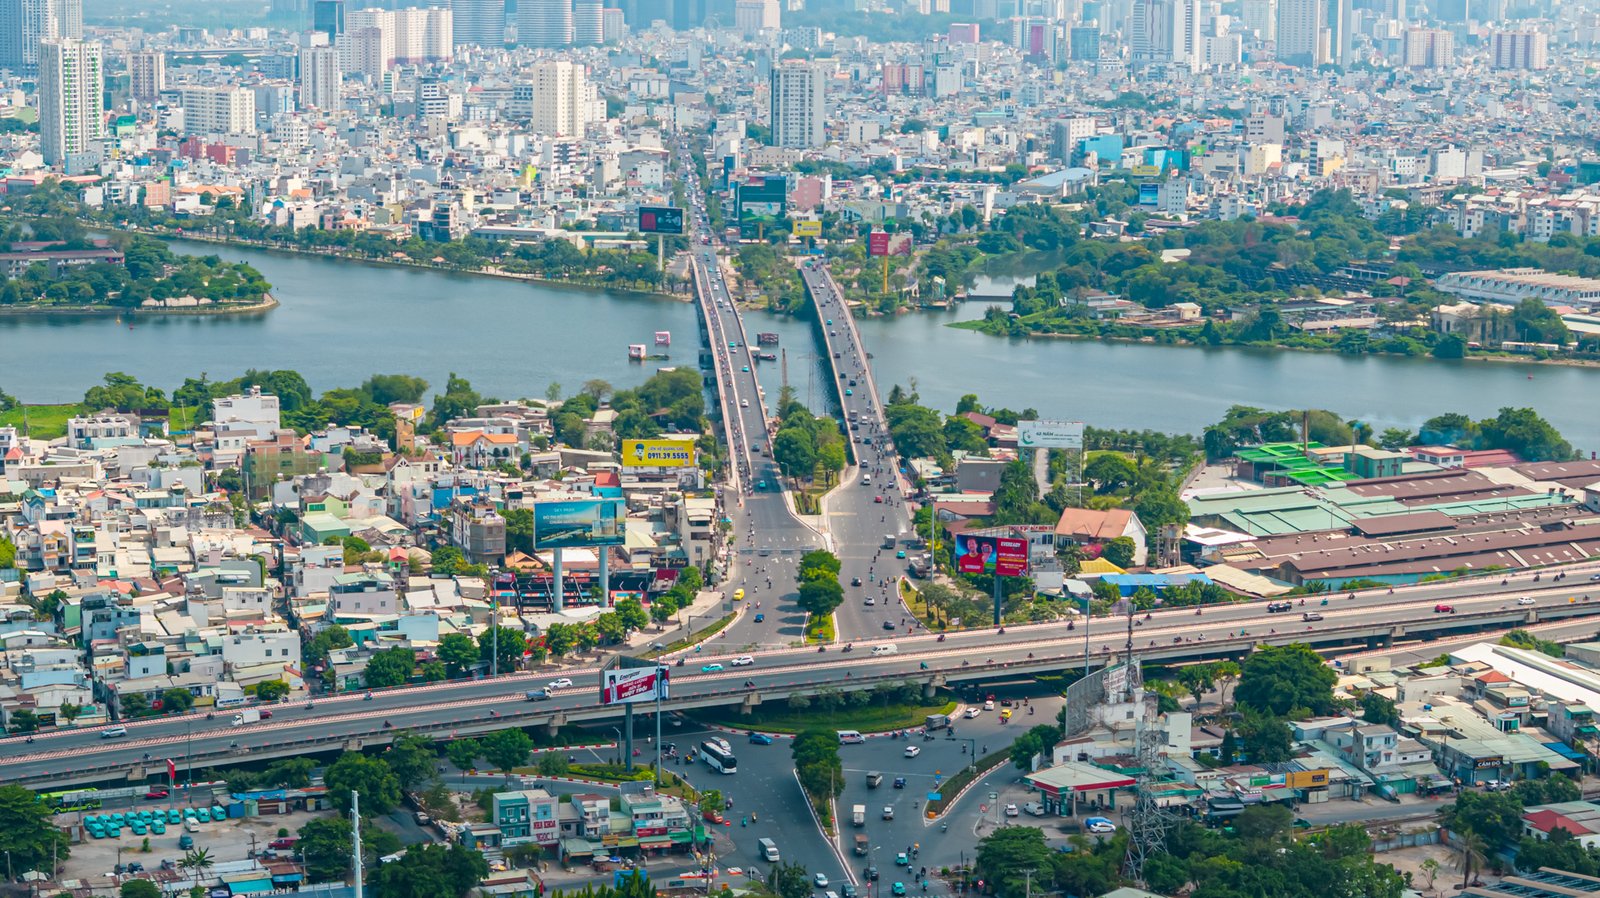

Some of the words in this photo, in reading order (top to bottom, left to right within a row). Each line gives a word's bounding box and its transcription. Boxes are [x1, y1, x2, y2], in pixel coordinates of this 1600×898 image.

[620, 671, 640, 680] Energizer
[622, 690, 635, 698] VƯỢT
[533, 821, 543, 829] NHA
[543, 820, 556, 828] KHOA
